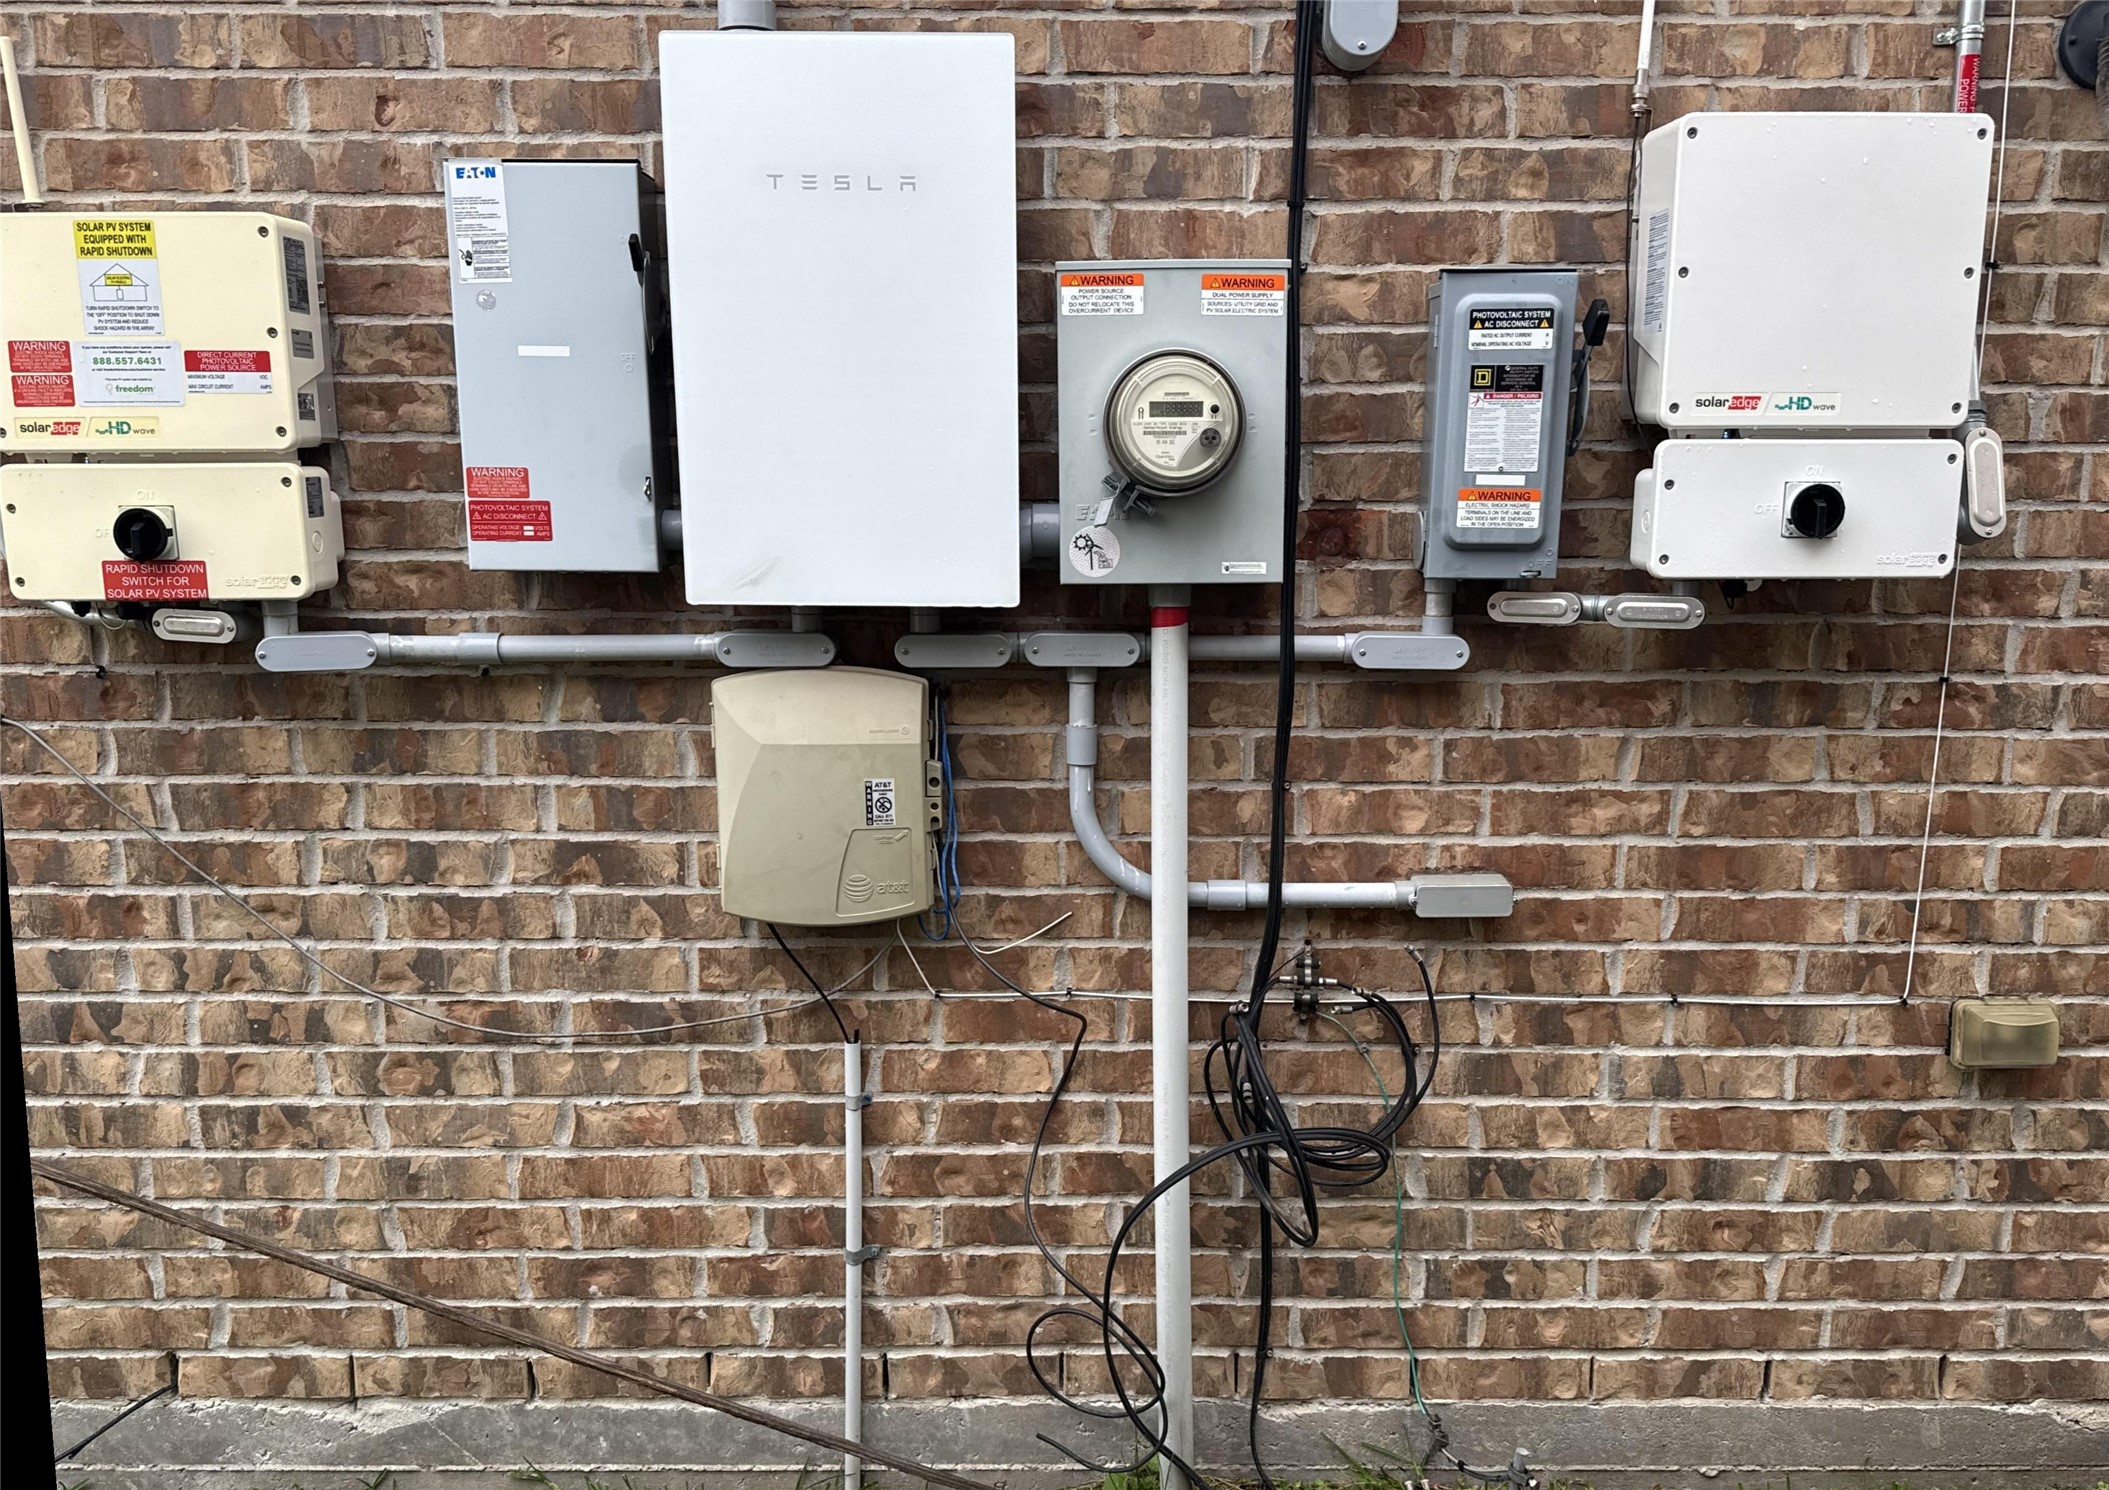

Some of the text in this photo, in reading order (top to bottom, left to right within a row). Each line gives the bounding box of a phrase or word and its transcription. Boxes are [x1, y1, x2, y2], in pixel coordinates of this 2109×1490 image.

[766, 174, 916, 191] TESLA
[77, 222, 151, 232] SOLAR PV SYSTEM
[84, 235, 146, 244] EQUIPPED WITH
[80, 247, 152, 256] RAPID SHUTDOWN
[1080, 276, 1134, 285] WARNING
[1221, 278, 1275, 288] WARNING
[13, 342, 66, 351] WARNING
[16, 376, 69, 385] WARNING
[1696, 396, 1760, 410] solaredge
[1789, 396, 1812, 410] HD
[20, 422, 80, 435] solaredge
[108, 421, 131, 434] HD
[471, 468, 524, 477] WARNING
[1478, 492, 1531, 501] WARNING
[95, 528, 112, 538] OF
[106, 565, 204, 573] RAPID SHUTDOWN
[122, 577, 190, 585] SWITCH FOR
[108, 589, 206, 598] SOLAR PV SYSTEM
[877, 880, 909, 894] at&t
